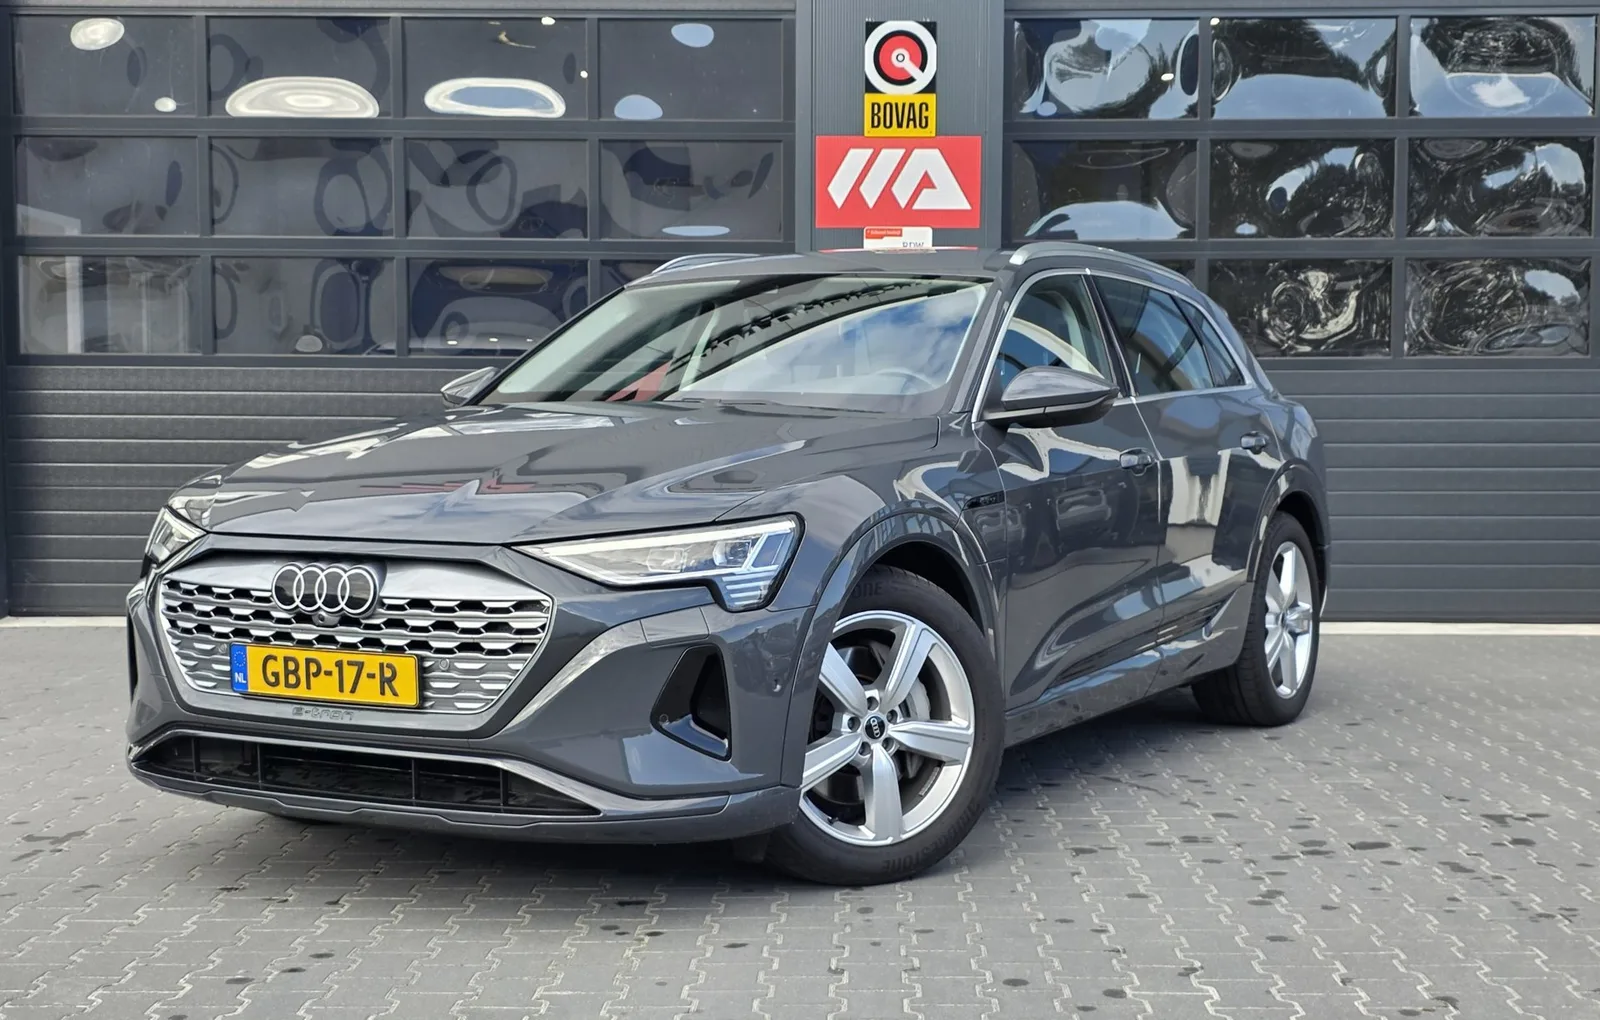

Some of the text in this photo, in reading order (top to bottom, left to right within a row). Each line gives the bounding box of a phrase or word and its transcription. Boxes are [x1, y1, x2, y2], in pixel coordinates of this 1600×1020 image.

[871, 101, 929, 129] BOVAG
[234, 672, 247, 683] NL
[261, 654, 399, 697] GBP-17-R
[292, 705, 355, 721] e-tron
